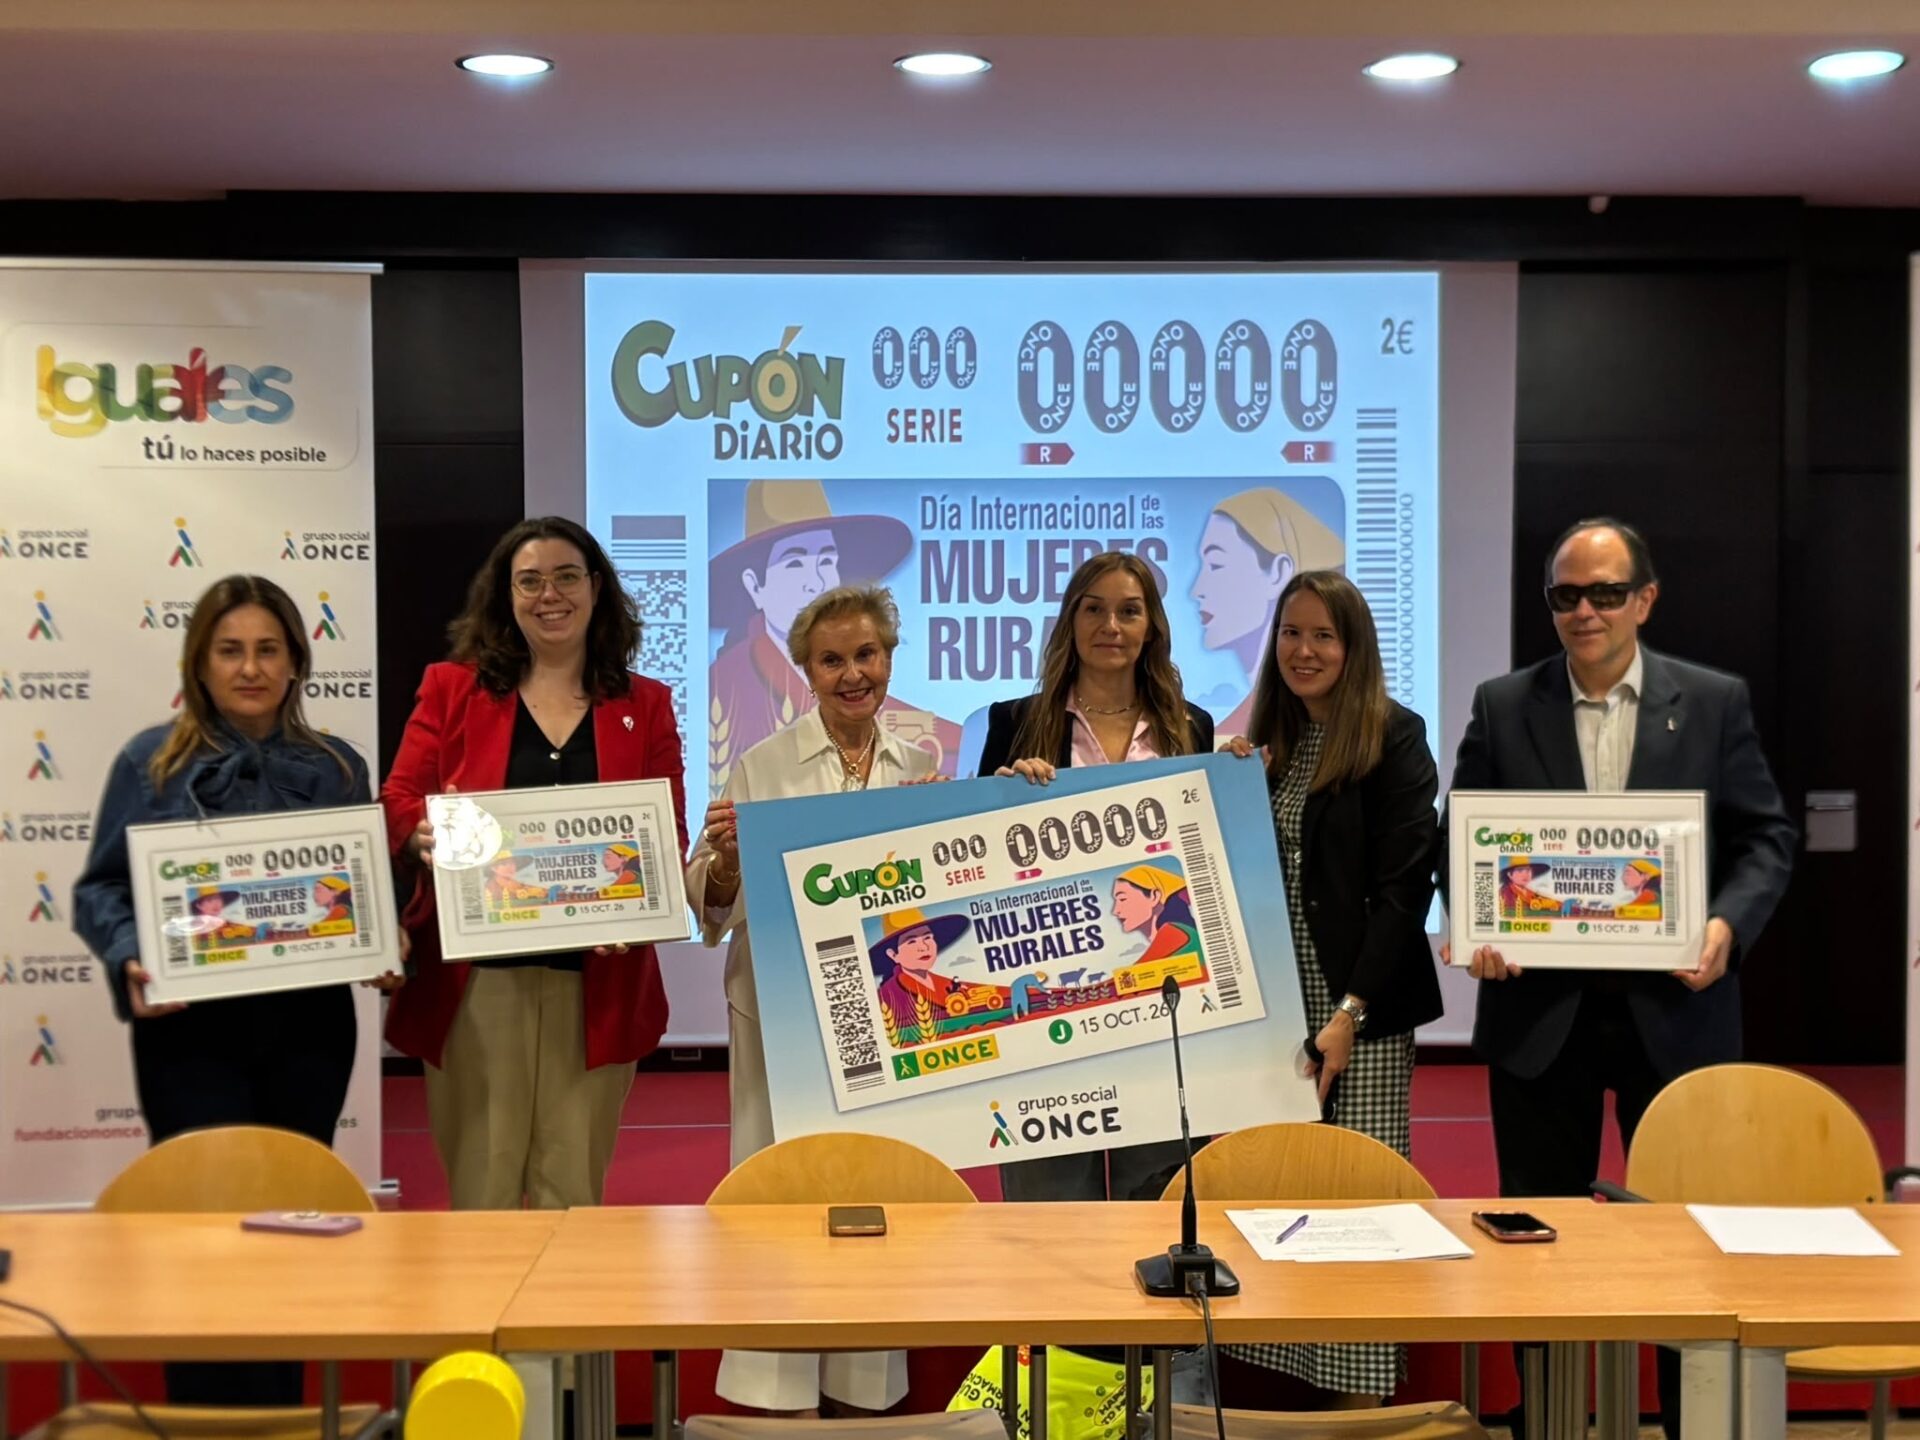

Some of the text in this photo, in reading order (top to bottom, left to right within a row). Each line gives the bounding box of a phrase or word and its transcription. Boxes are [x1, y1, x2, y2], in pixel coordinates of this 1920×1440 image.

[1020, 326, 1052, 372] ONCE
[1086, 326, 1118, 371] ONCE
[1152, 325, 1184, 371] ONCE
[1218, 325, 1250, 371] ONCE
[1284, 324, 1315, 370] ONCE
[872, 326, 977, 389] 000
[1017, 319, 1338, 434] 00000
[1380, 317, 1415, 355] 2€
[1040, 383, 1071, 429] ONCE
[1105, 382, 1136, 429] ONCE
[1171, 382, 1202, 428] ONCE
[1237, 382, 1268, 428] ONCE
[1302, 381, 1334, 427] ONCE
[886, 408, 963, 443] SERIE
[142, 434, 327, 464] tú lo haces posible
[1040, 446, 1051, 463] R
[1303, 444, 1315, 461] R
[920, 495, 1160, 531] Día Internacional de
[1141, 513, 1164, 529] las
[18, 542, 88, 558] ONCE
[303, 544, 370, 560] ONCE
[308, 671, 338, 680] rupo
[20, 683, 90, 699] ONCE
[304, 682, 372, 699] ONCE
[1181, 788, 1201, 804] 2€
[21, 825, 90, 841] ONCE
[519, 821, 546, 833] 000
[555, 814, 634, 838] 00000
[932, 834, 987, 867] 000
[1006, 797, 1168, 868] 00000
[1539, 828, 1567, 840] 000
[1576, 827, 1660, 850] 00000
[263, 844, 345, 871] 00000
[535, 853, 597, 870] MUJERES
[538, 866, 597, 882] RURALES
[945, 865, 986, 886] SERIE
[1552, 867, 1616, 881] MUJERES
[1554, 881, 1614, 895] RURALES
[240, 887, 307, 906] MUJERES
[245, 901, 307, 919] RURALES
[969, 899, 993, 916] Día
[995, 881, 1079, 911] Internacional
[973, 894, 1101, 944] MUJERES
[1513, 922, 1549, 932] ONCE
[983, 924, 1104, 973] RURALES
[22, 967, 92, 983] ONCE
[1056, 1001, 1170, 1040] J 15 OCT. 26
[923, 1039, 993, 1070] ONCE
[1018, 1085, 1118, 1115] grupo social
[1021, 1107, 1122, 1143] ONCE
